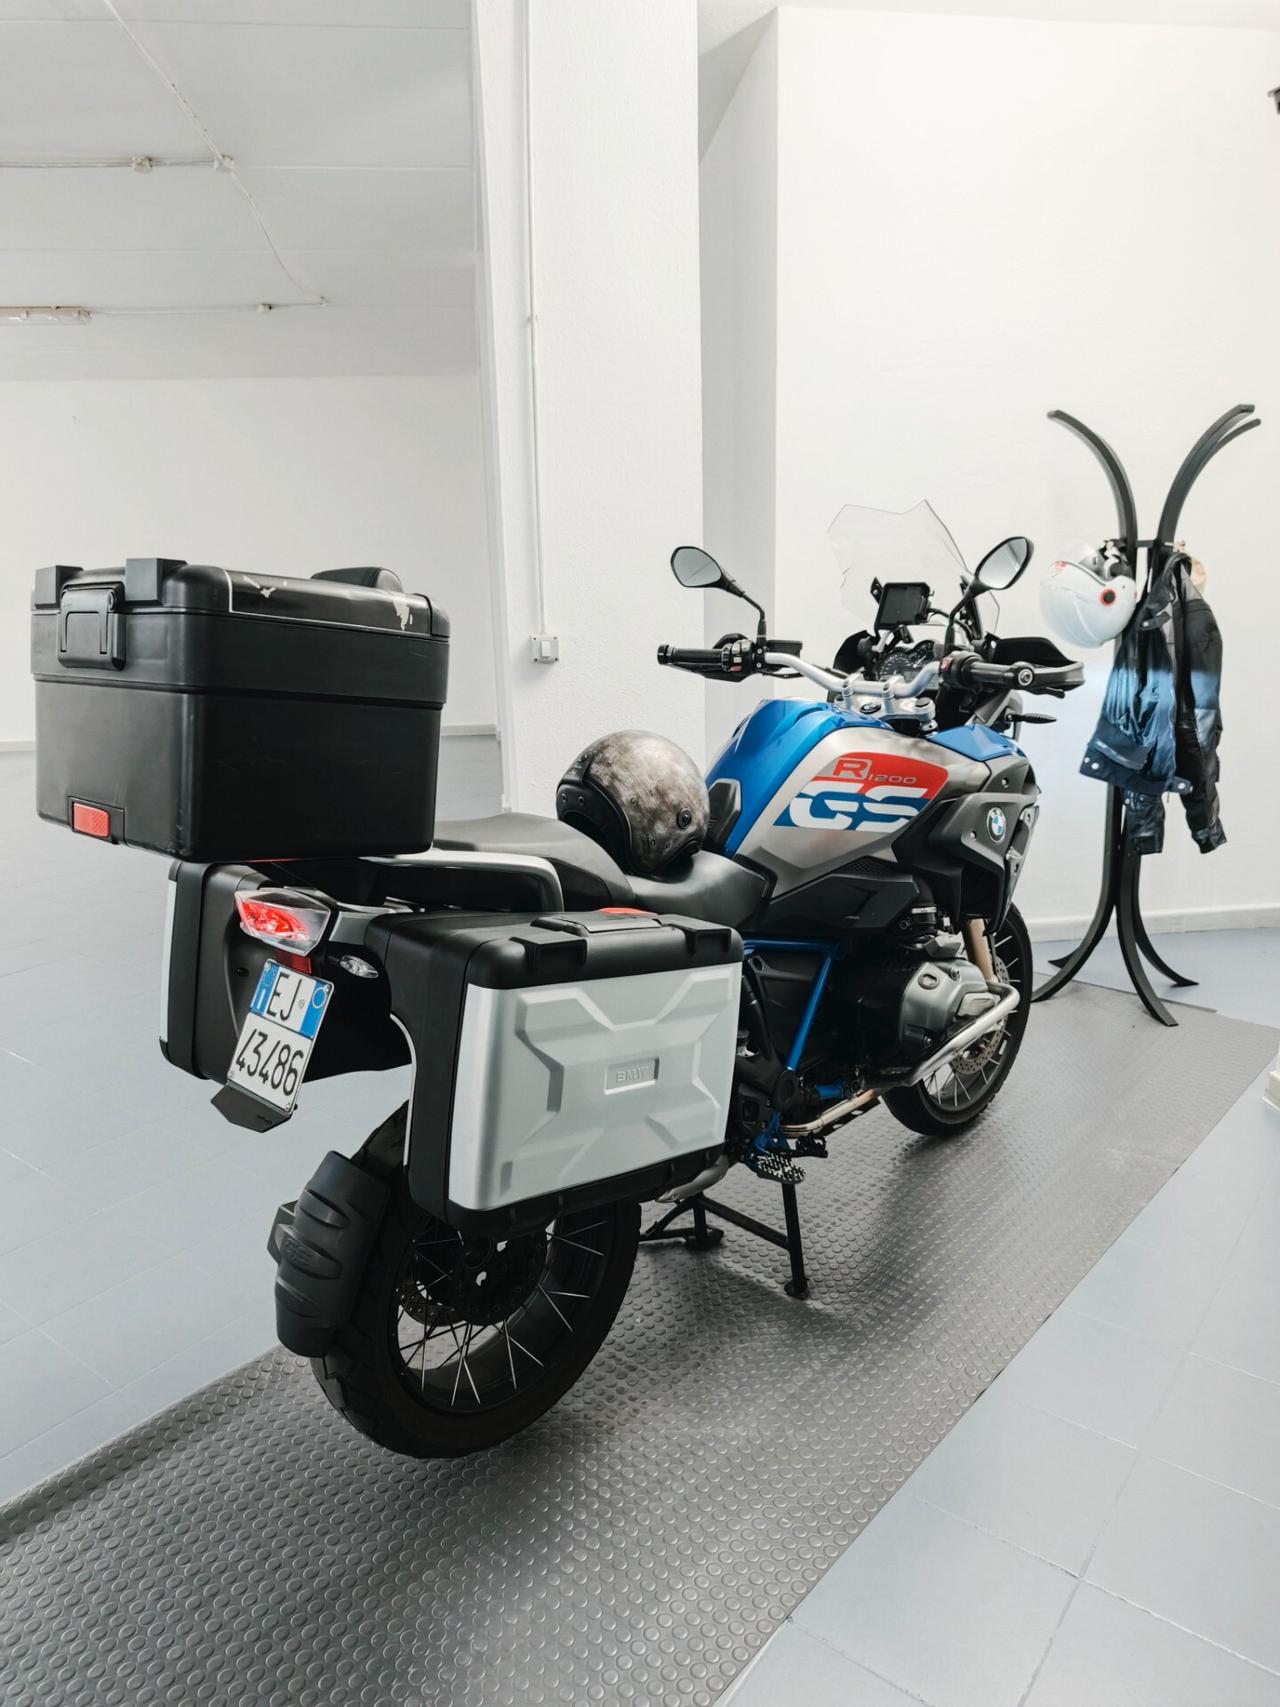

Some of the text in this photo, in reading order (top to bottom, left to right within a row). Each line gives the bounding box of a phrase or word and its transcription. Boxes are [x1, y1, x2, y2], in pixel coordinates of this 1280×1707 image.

[832, 758, 917, 784] R 1200
[789, 780, 928, 833] GS
[266, 971, 303, 1021] EJ
[235, 1028, 304, 1097] 43486
[616, 1065, 649, 1082] BMW
